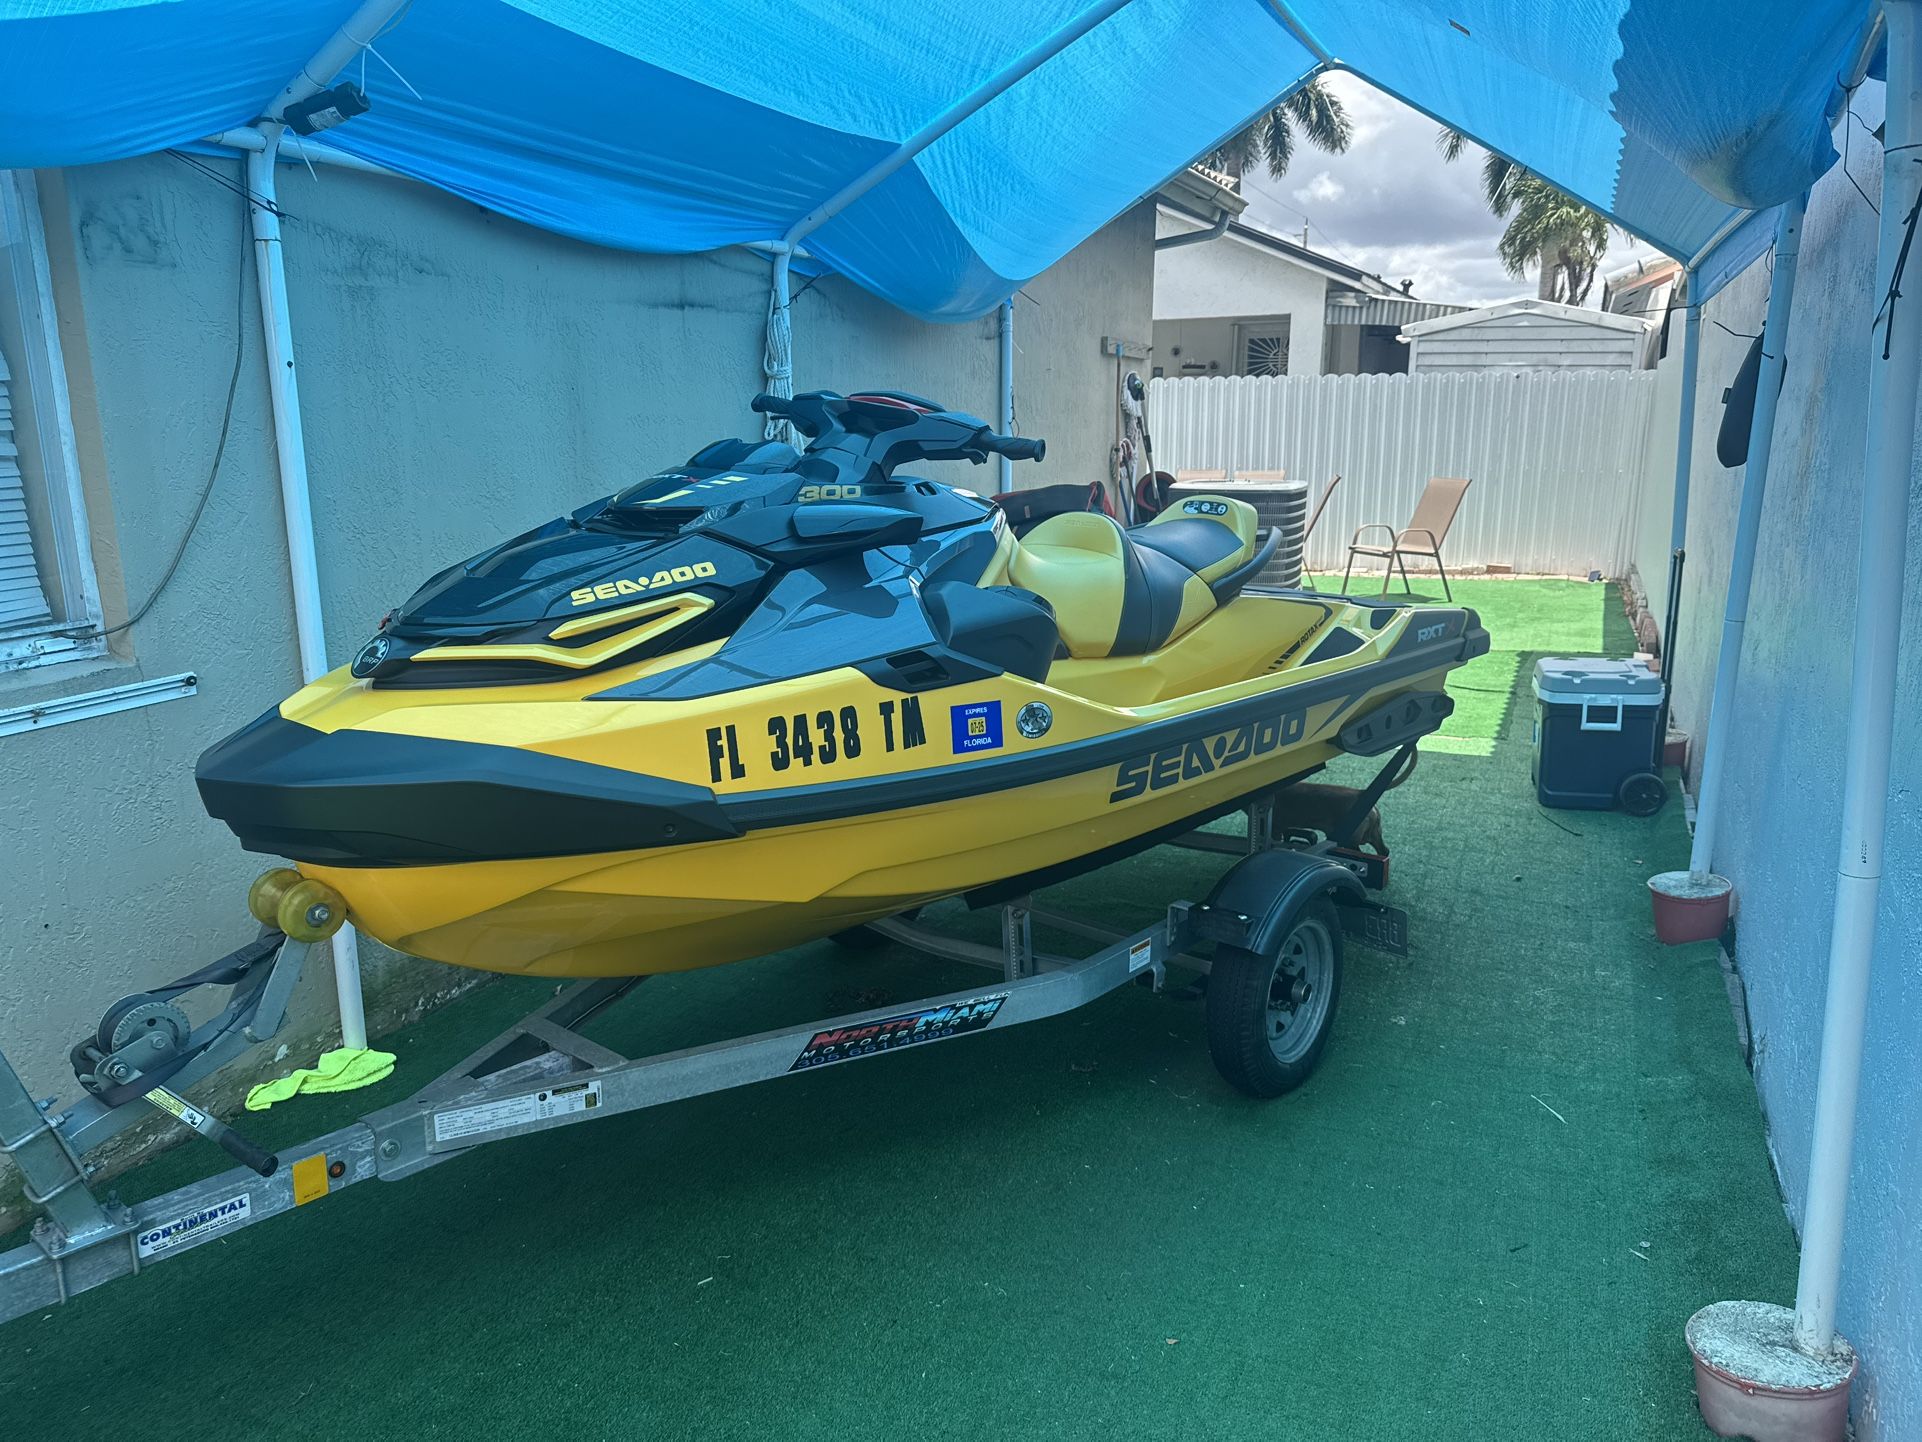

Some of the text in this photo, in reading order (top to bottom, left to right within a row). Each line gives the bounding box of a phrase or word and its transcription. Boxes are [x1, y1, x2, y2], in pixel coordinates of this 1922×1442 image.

[798, 485, 861, 502] 300
[1300, 622, 1319, 646] ROTAX
[1417, 623, 1445, 642] RXT
[362, 655, 379, 664] BRP
[965, 707, 987, 715] EXPIRES
[970, 720, 984, 734] 07-25
[706, 696, 926, 783] FL 3438 TM
[964, 737, 992, 747] FLORIDA
[801, 1012, 994, 1059] MOTORSPORTS
[797, 1027, 954, 1068] 305.651.4999
[140, 1198, 247, 1246] CONTINENTAL
